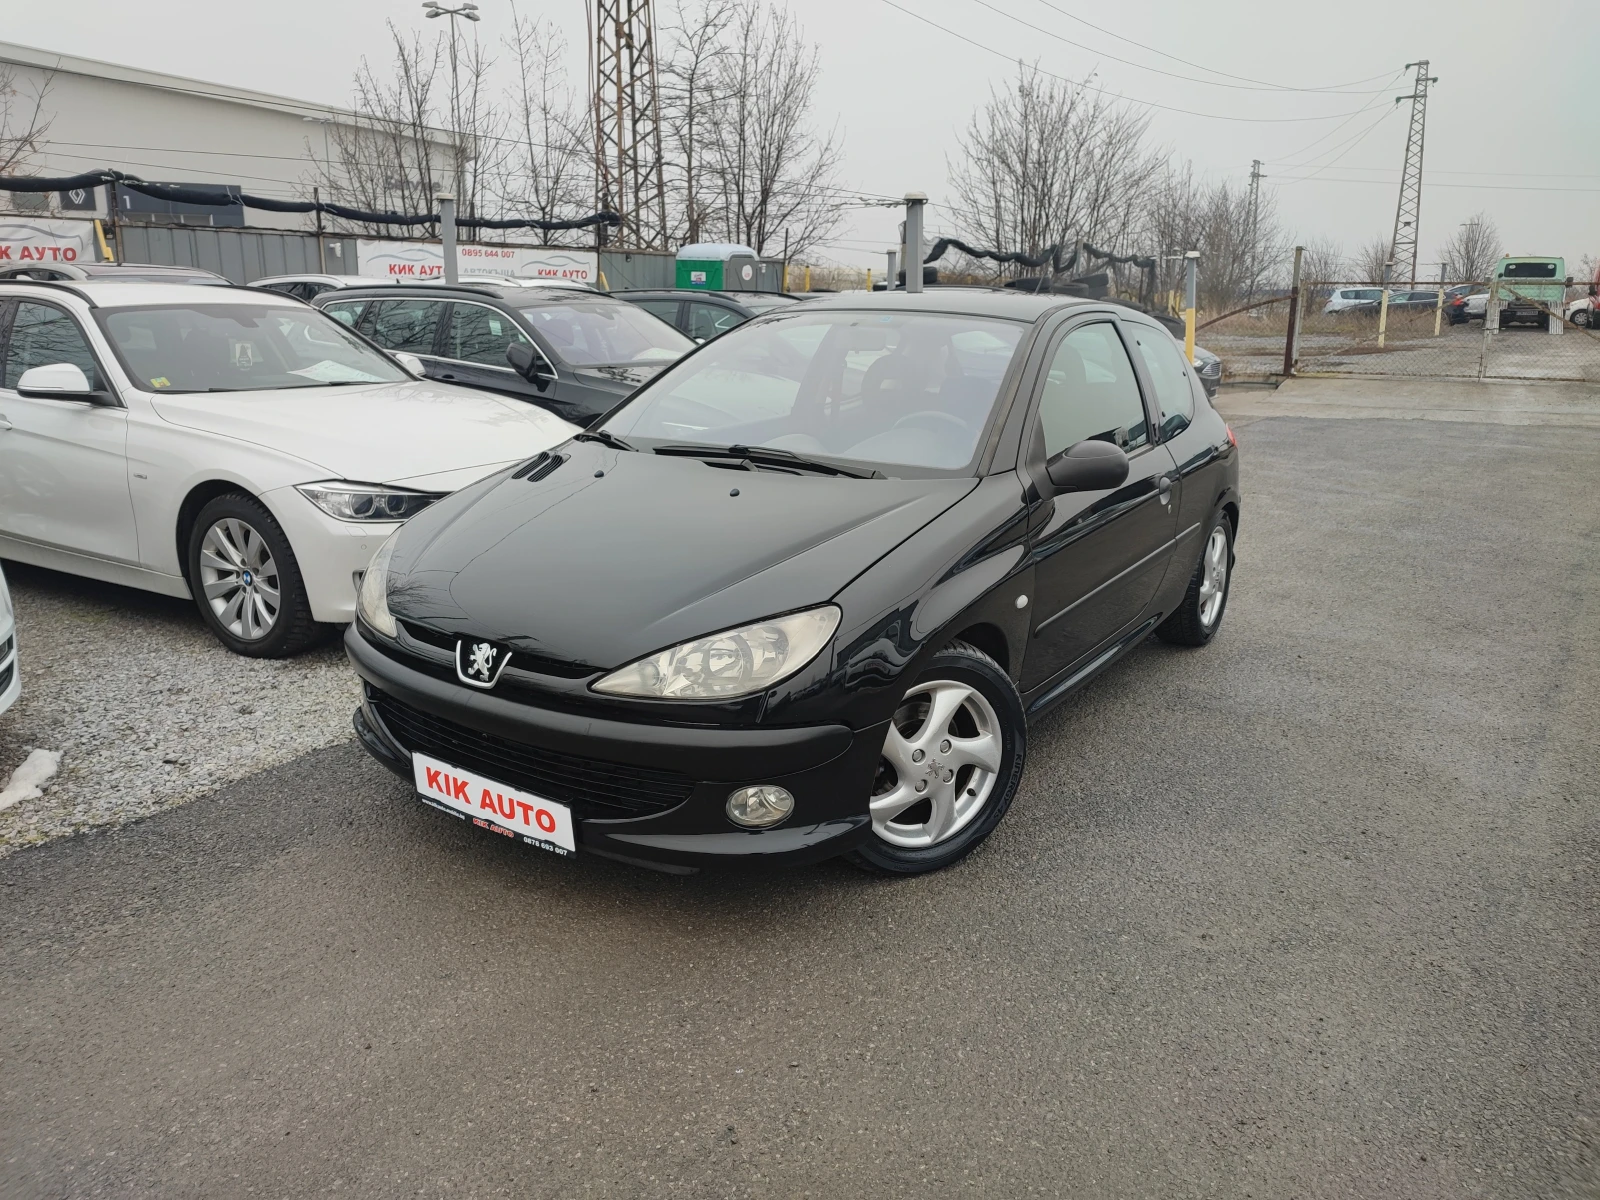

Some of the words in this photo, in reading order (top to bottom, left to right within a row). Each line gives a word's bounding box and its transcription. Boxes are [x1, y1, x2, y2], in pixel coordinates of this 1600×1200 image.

[19, 245, 77, 262] АУТО
[462, 248, 482, 257] 0895
[484, 250, 499, 258] 644
[501, 250, 515, 258] 007
[388, 263, 415, 276] КИК
[419, 264, 446, 276] АУТ
[537, 269, 559, 277] КИК
[562, 269, 588, 280] АУТО
[425, 766, 472, 805] KIK
[480, 788, 557, 833] AUTO
[472, 817, 489, 830] KIK
[489, 823, 515, 839] AUTO
[555, 847, 568, 856] 007
